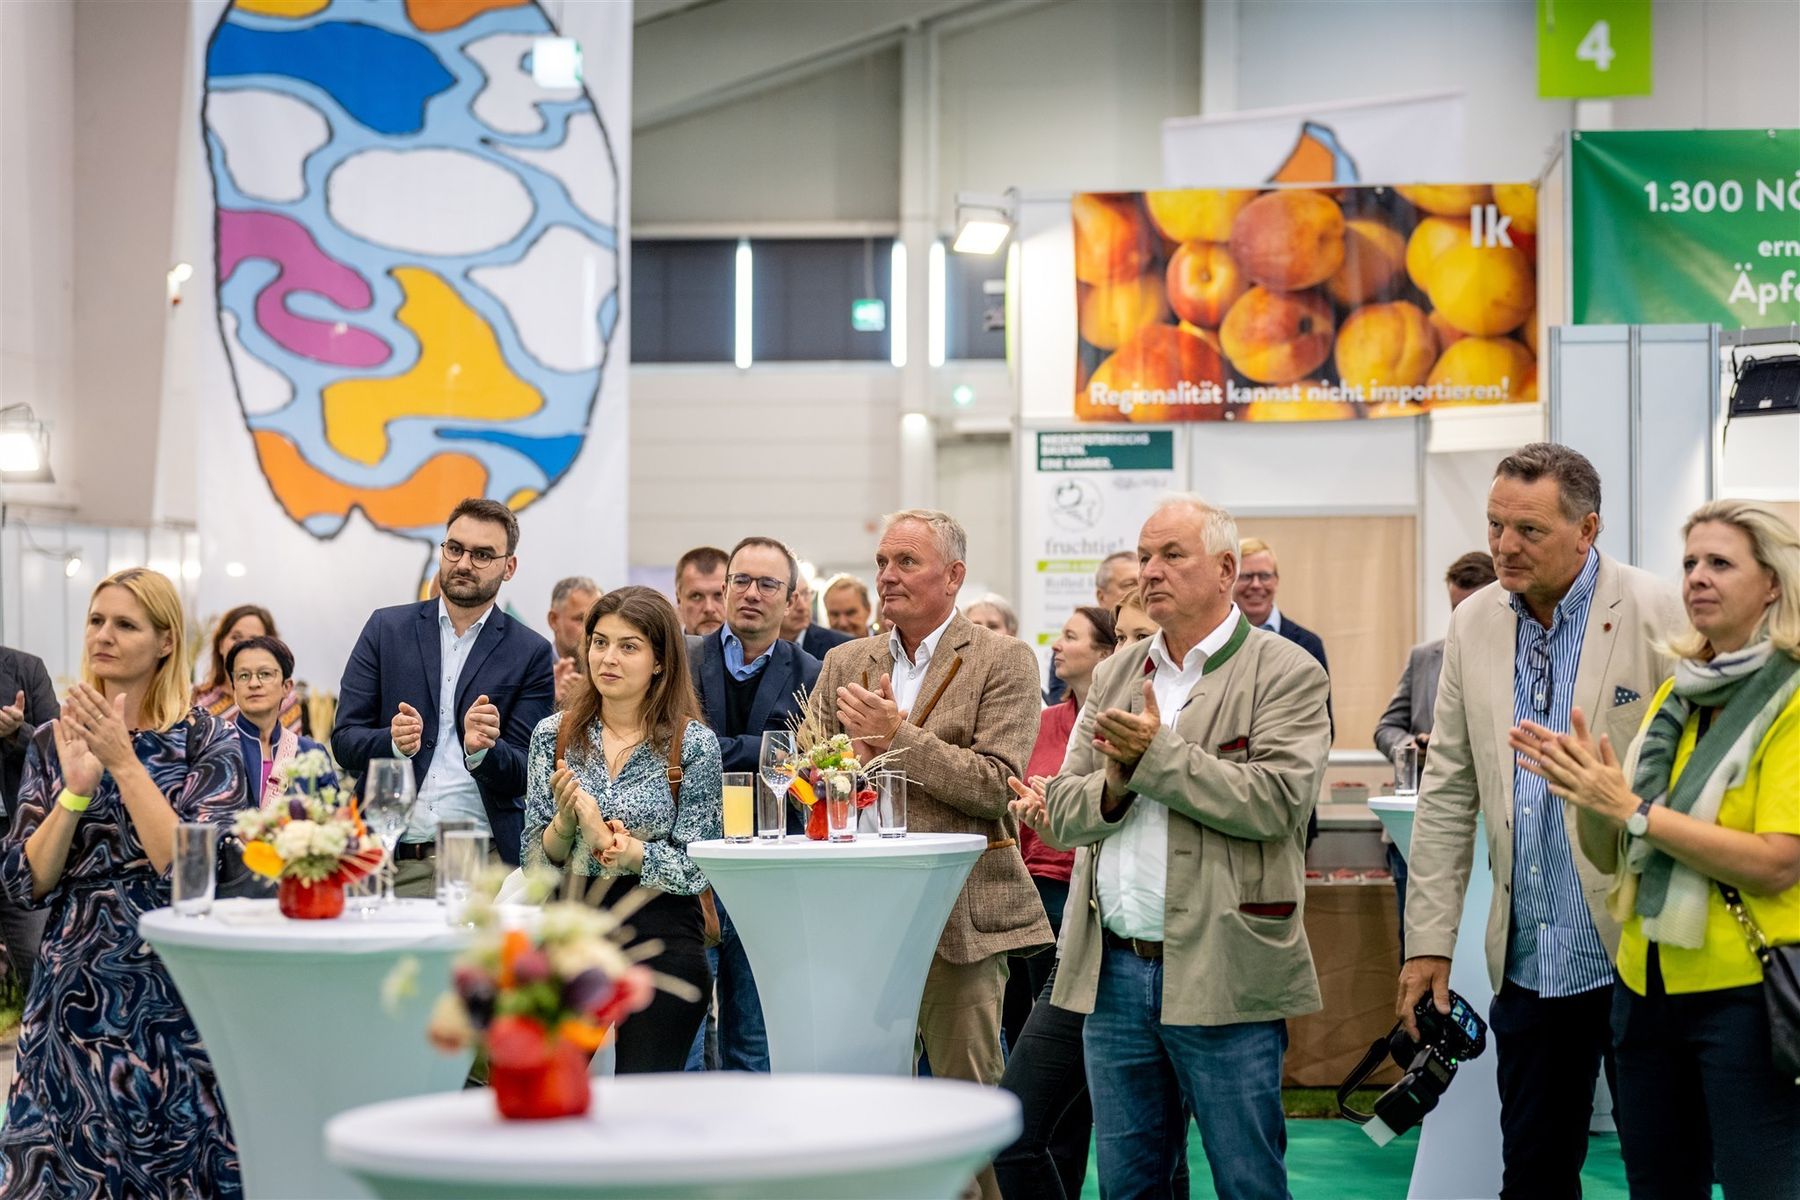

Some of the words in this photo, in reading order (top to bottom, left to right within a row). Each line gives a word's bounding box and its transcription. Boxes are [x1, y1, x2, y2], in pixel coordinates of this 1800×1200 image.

[1575, 19, 1616, 72] 4
[1643, 179, 1744, 213] 1.300
[1089, 380, 1223, 414] Regionalität
[1226, 379, 1302, 404] kannst
[1307, 379, 1364, 403] nicht
[1370, 377, 1510, 408] importieren!
